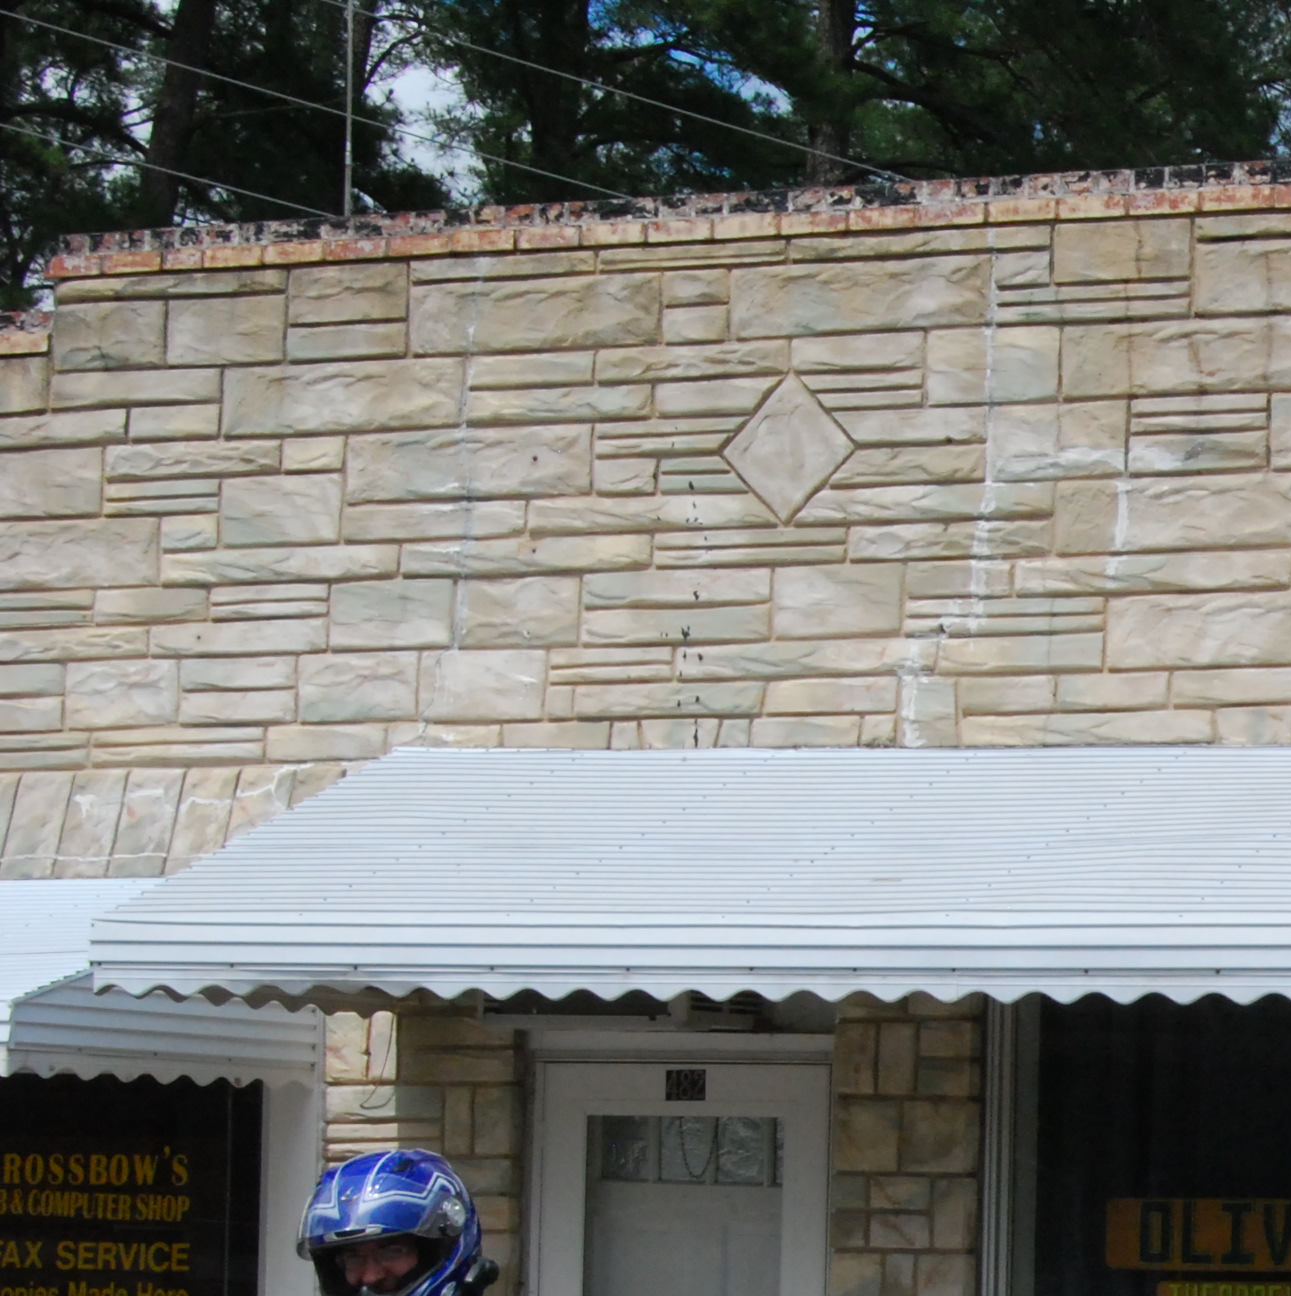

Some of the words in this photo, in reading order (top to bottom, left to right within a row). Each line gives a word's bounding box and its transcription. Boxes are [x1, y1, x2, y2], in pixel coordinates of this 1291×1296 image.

[28, 1189, 131, 1220] COMPUTER
[135, 1194, 190, 1222] SHOP
[0, 1241, 43, 1268] AX
[56, 1240, 190, 1272] SERVICE
